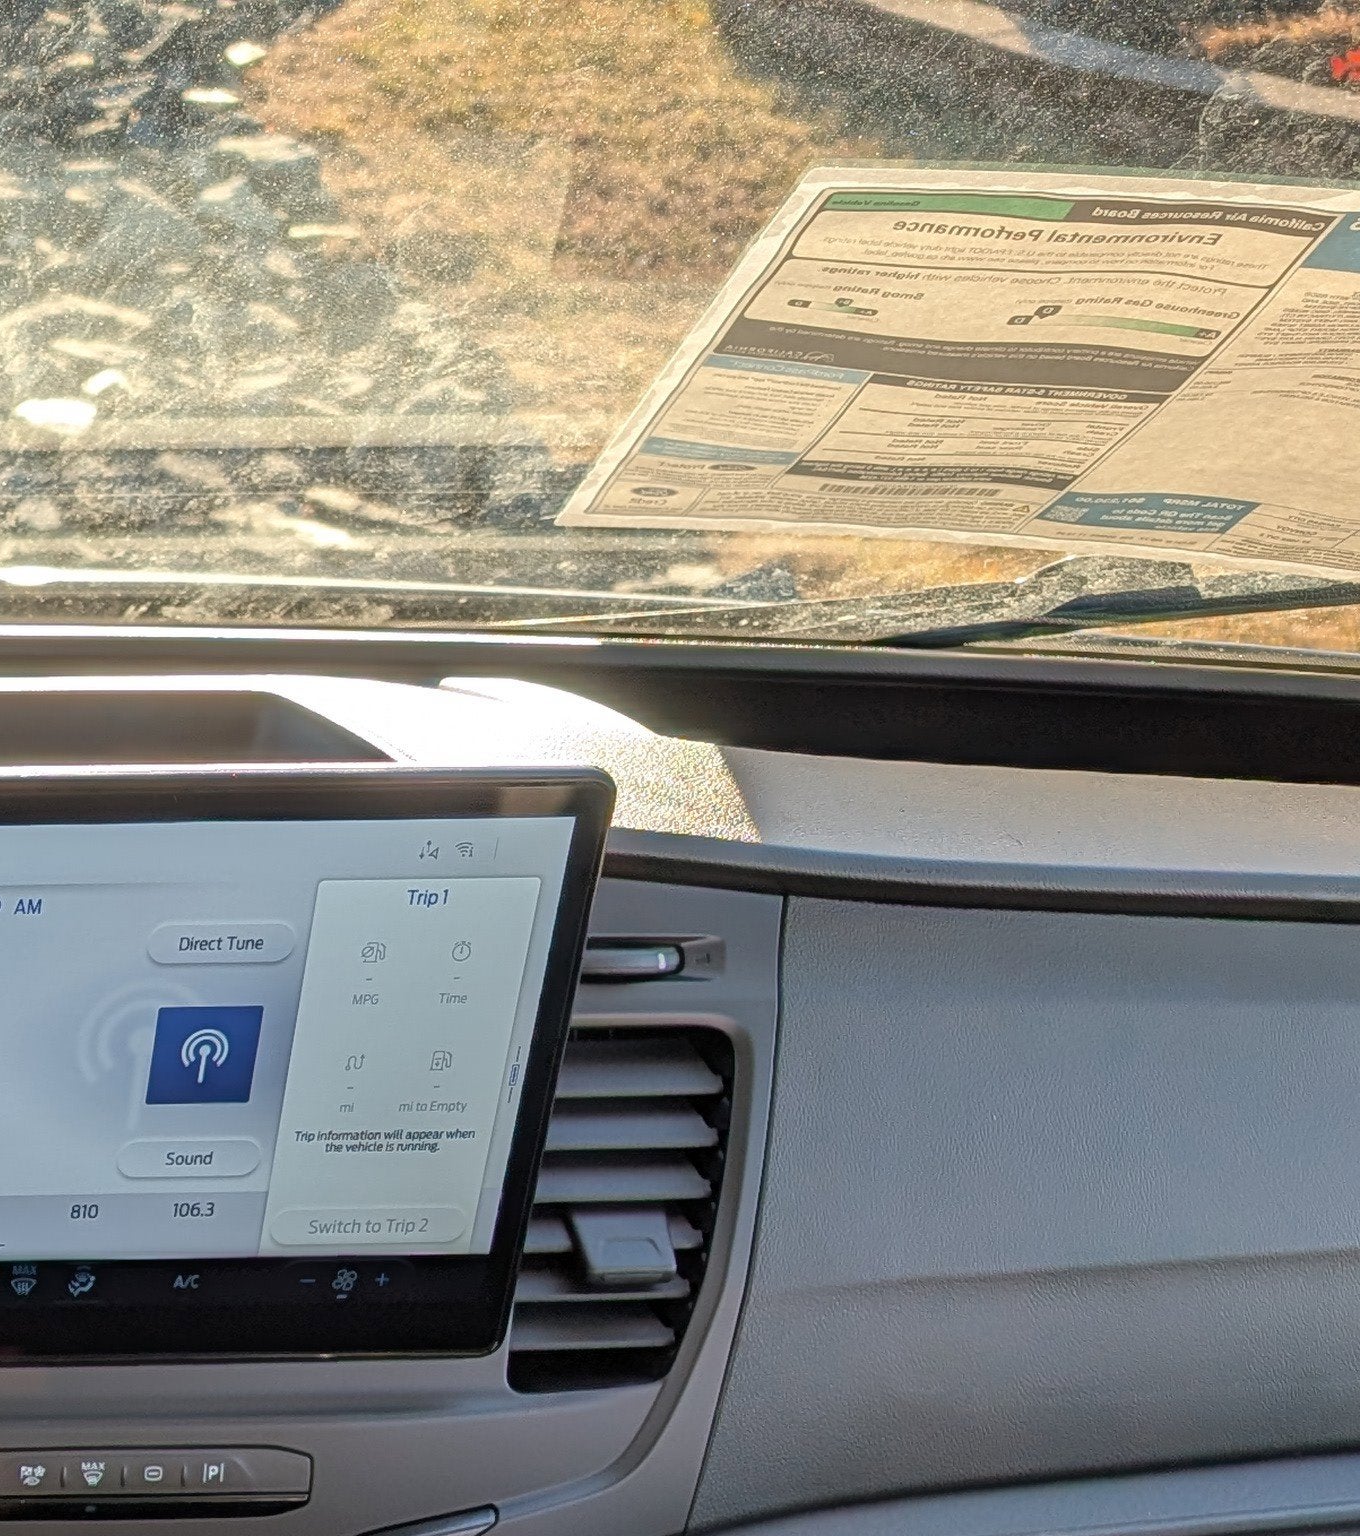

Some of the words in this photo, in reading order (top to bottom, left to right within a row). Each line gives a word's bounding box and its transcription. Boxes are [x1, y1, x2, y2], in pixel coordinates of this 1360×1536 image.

[406, 888, 440, 908] Trip
[442, 888, 450, 905] 1
[12, 898, 43, 915] AM
[178, 936, 224, 952] Direct
[225, 935, 265, 952] Tune
[351, 993, 381, 1006] MPG
[438, 992, 468, 1005] Time
[338, 1102, 355, 1113] mi
[398, 1101, 414, 1113] mi
[416, 1101, 429, 1113] to
[429, 1100, 469, 1114] Empty
[293, 1129, 315, 1143] Trip
[316, 1129, 381, 1142] information
[381, 1128, 404, 1141] will
[404, 1129, 444, 1143] appear
[444, 1128, 477, 1141] when
[324, 1140, 343, 1153] the
[344, 1140, 384, 1153] vehicle
[385, 1140, 396, 1152] is
[396, 1140, 441, 1154] running.
[164, 1151, 214, 1167] Sound
[69, 1203, 99, 1219] 810
[172, 1201, 216, 1218] 106.3
[307, 1217, 362, 1235] Switch
[363, 1219, 382, 1234] to
[384, 1216, 418, 1237] Trip
[418, 1217, 430, 1233] 2
[11, 1265, 39, 1276] MAX
[173, 1273, 202, 1289] A/C
[81, 1462, 106, 1471] MAX
